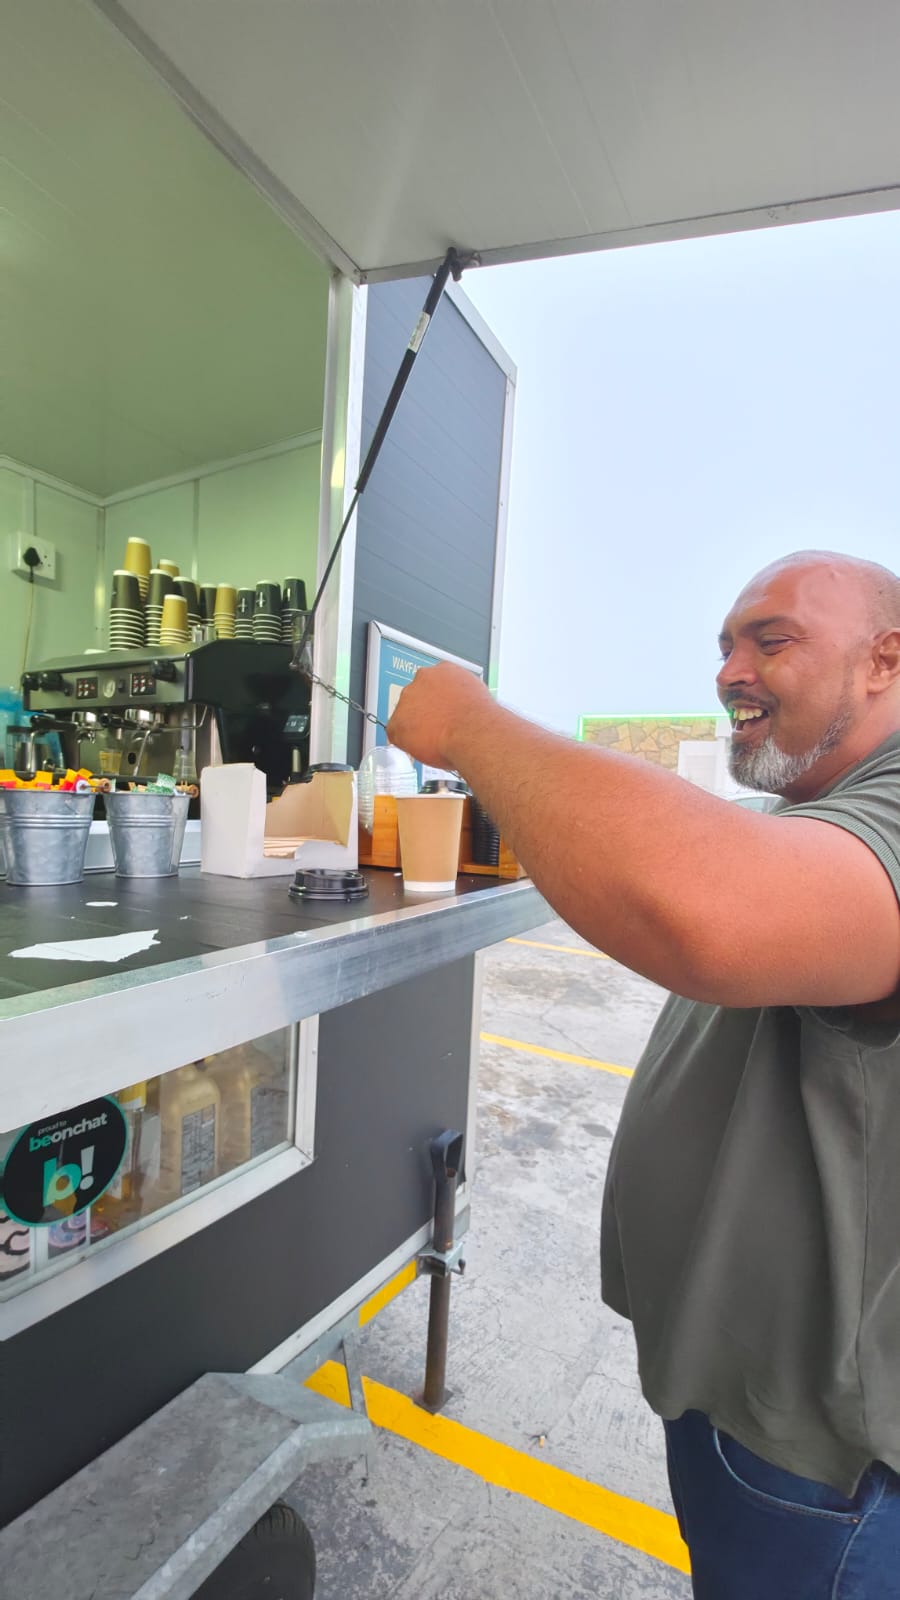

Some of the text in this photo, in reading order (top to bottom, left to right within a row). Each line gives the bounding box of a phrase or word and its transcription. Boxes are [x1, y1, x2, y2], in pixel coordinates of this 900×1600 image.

[392, 656, 420, 674] WAYFA
[29, 1112, 108, 1152] beonchat
[38, 1121, 58, 1136] proud
